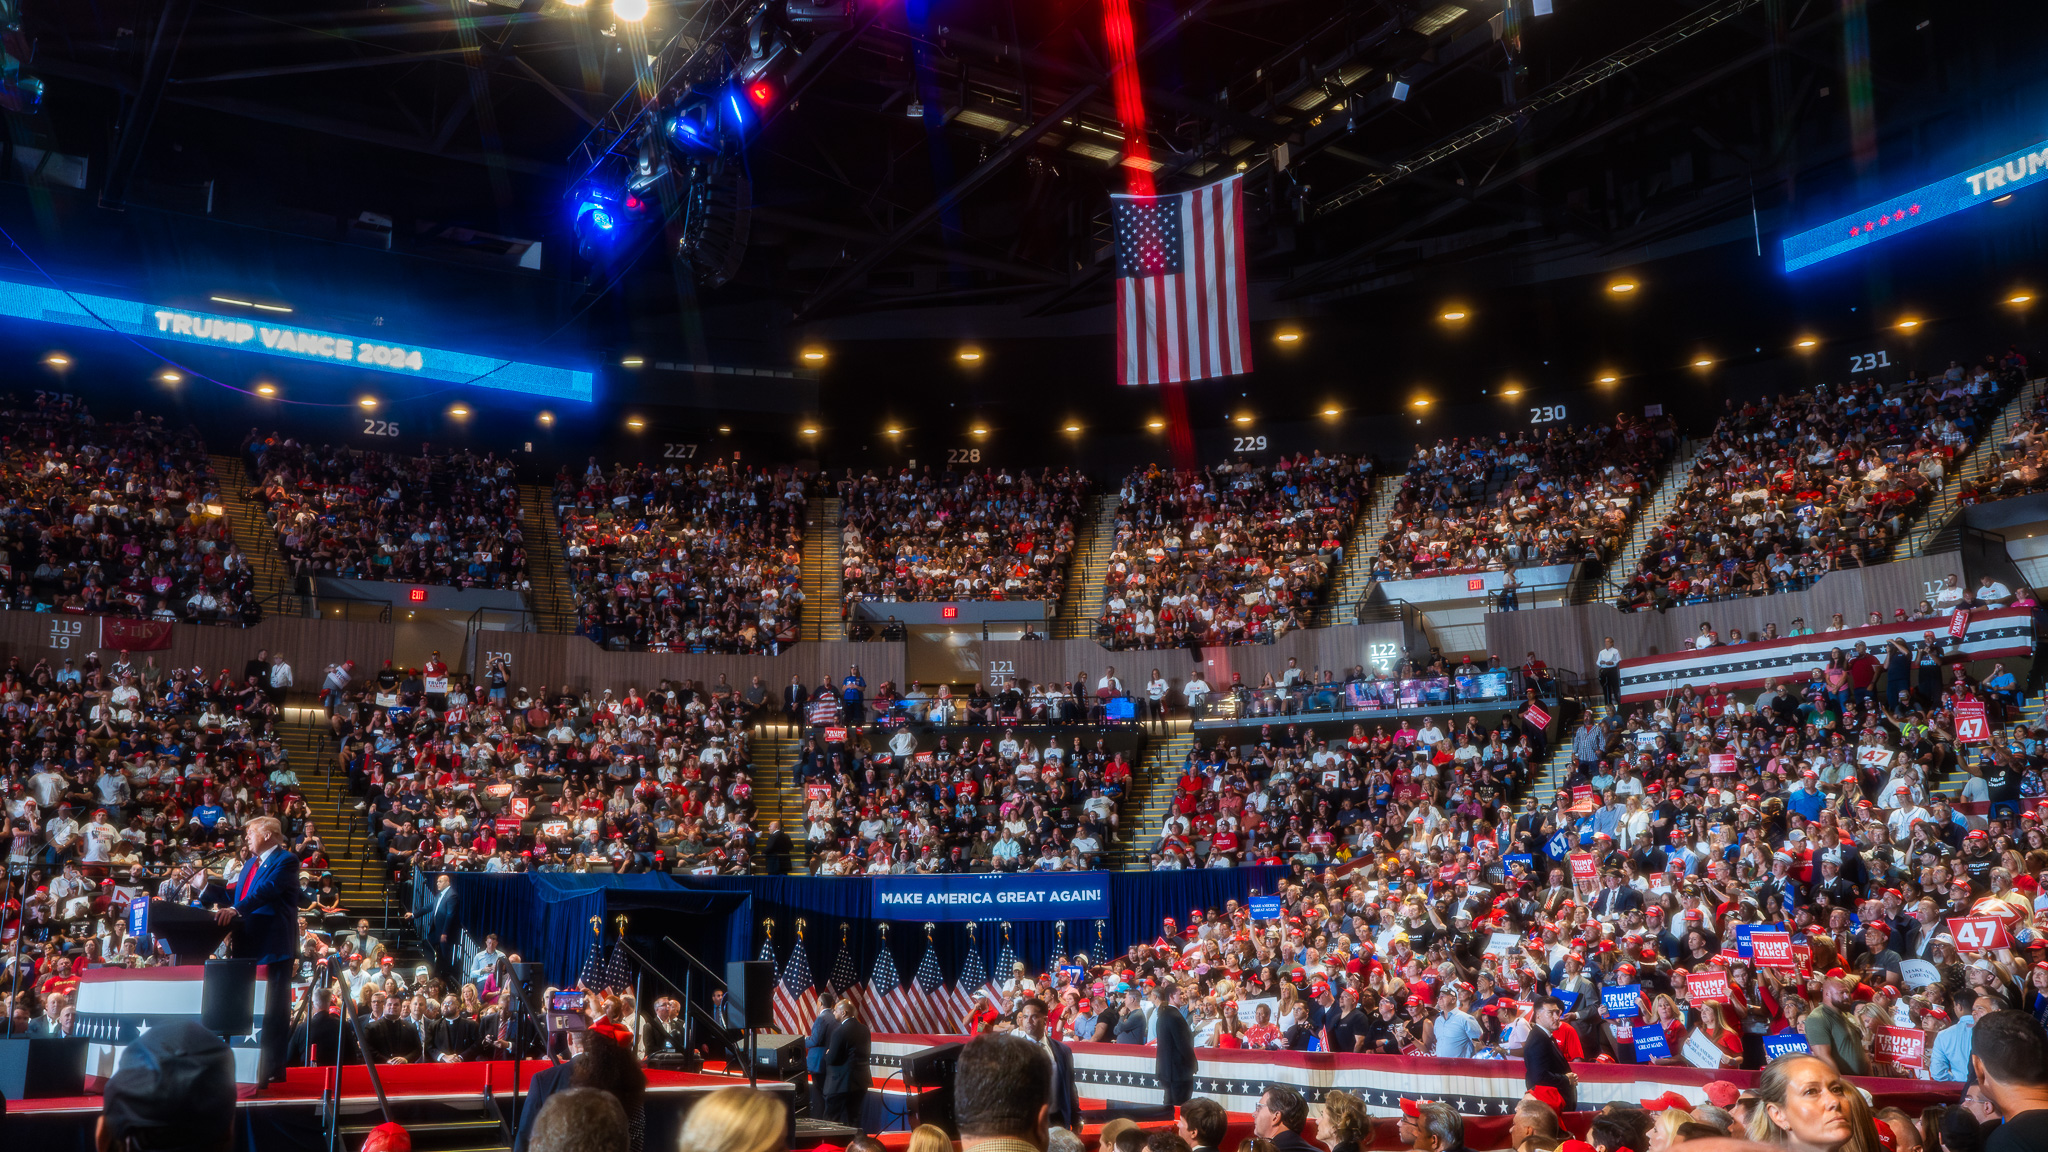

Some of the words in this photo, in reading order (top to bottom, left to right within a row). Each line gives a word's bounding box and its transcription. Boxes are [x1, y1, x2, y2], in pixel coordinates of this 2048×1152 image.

[154, 311, 254, 343] TRUMP
[260, 328, 353, 359] VANCE
[357, 343, 423, 370] 2024
[1850, 350, 1892, 373] 231
[1530, 404, 1566, 424] 230
[363, 419, 400, 437] 226
[1233, 435, 1267, 452] 229
[663, 443, 698, 459] 227
[947, 448, 981, 463] 228
[1470, 579, 1482, 590] EXIT
[411, 590, 425, 600] EXIT
[943, 607, 956, 618] EXIT
[51, 619, 82, 634] 119
[50, 635, 70, 649] 19
[1370, 643, 1396, 657] 122
[990, 661, 1015, 672] 121
[990, 675, 1004, 686] 21
[448, 709, 463, 722] 47
[1959, 718, 1983, 738] 47
[1863, 750, 1888, 762] 47
[514, 800, 526, 818] 47
[545, 825, 564, 835] 47
[1551, 834, 1568, 857] 47
[1571, 858, 1593, 866] TRUMP
[881, 893, 923, 904] MAKE
[926, 892, 993, 904] AMERICA
[996, 891, 1045, 903] GREAT
[1049, 889, 1101, 902] AGAIN!
[1957, 920, 1997, 947] 47
[1753, 941, 1789, 950] TRUMP
[1758, 949, 1787, 957] VANCE
[1689, 979, 1725, 990] TRUMP
[1604, 992, 1638, 1003] TRUMP
[1693, 987, 1722, 996] VANCE
[1608, 1000, 1635, 1008] VANCE
[1767, 1042, 1807, 1053] TRUMP
[1878, 1034, 1921, 1048] TRUMP
[1880, 1043, 1915, 1056] VANCE
